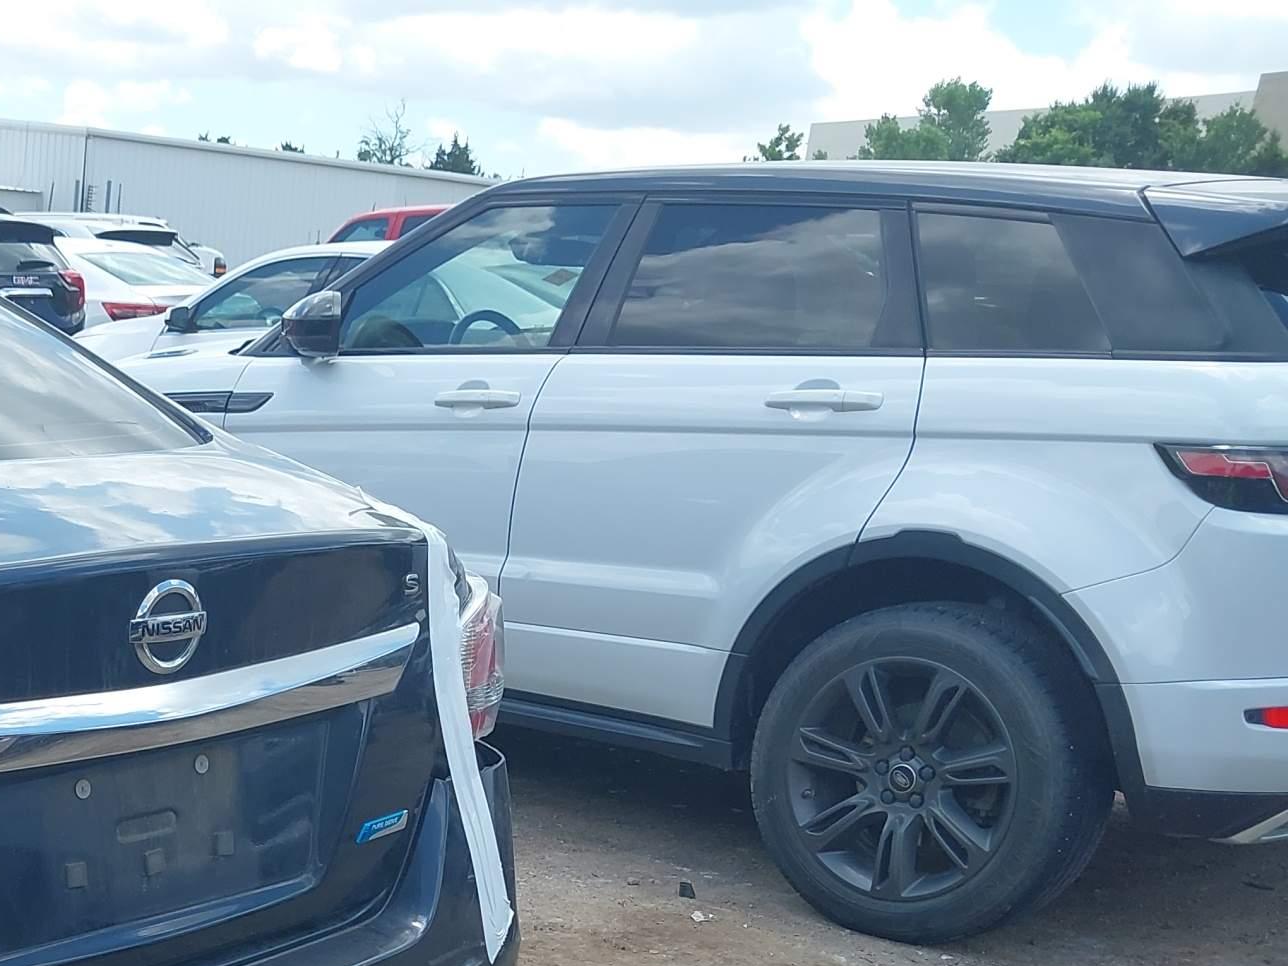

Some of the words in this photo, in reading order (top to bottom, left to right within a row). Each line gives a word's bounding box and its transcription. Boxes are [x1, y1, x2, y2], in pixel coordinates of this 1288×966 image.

[12, 275, 40, 286] GMC
[403, 573, 420, 596] S
[141, 613, 203, 638] NISSAN
